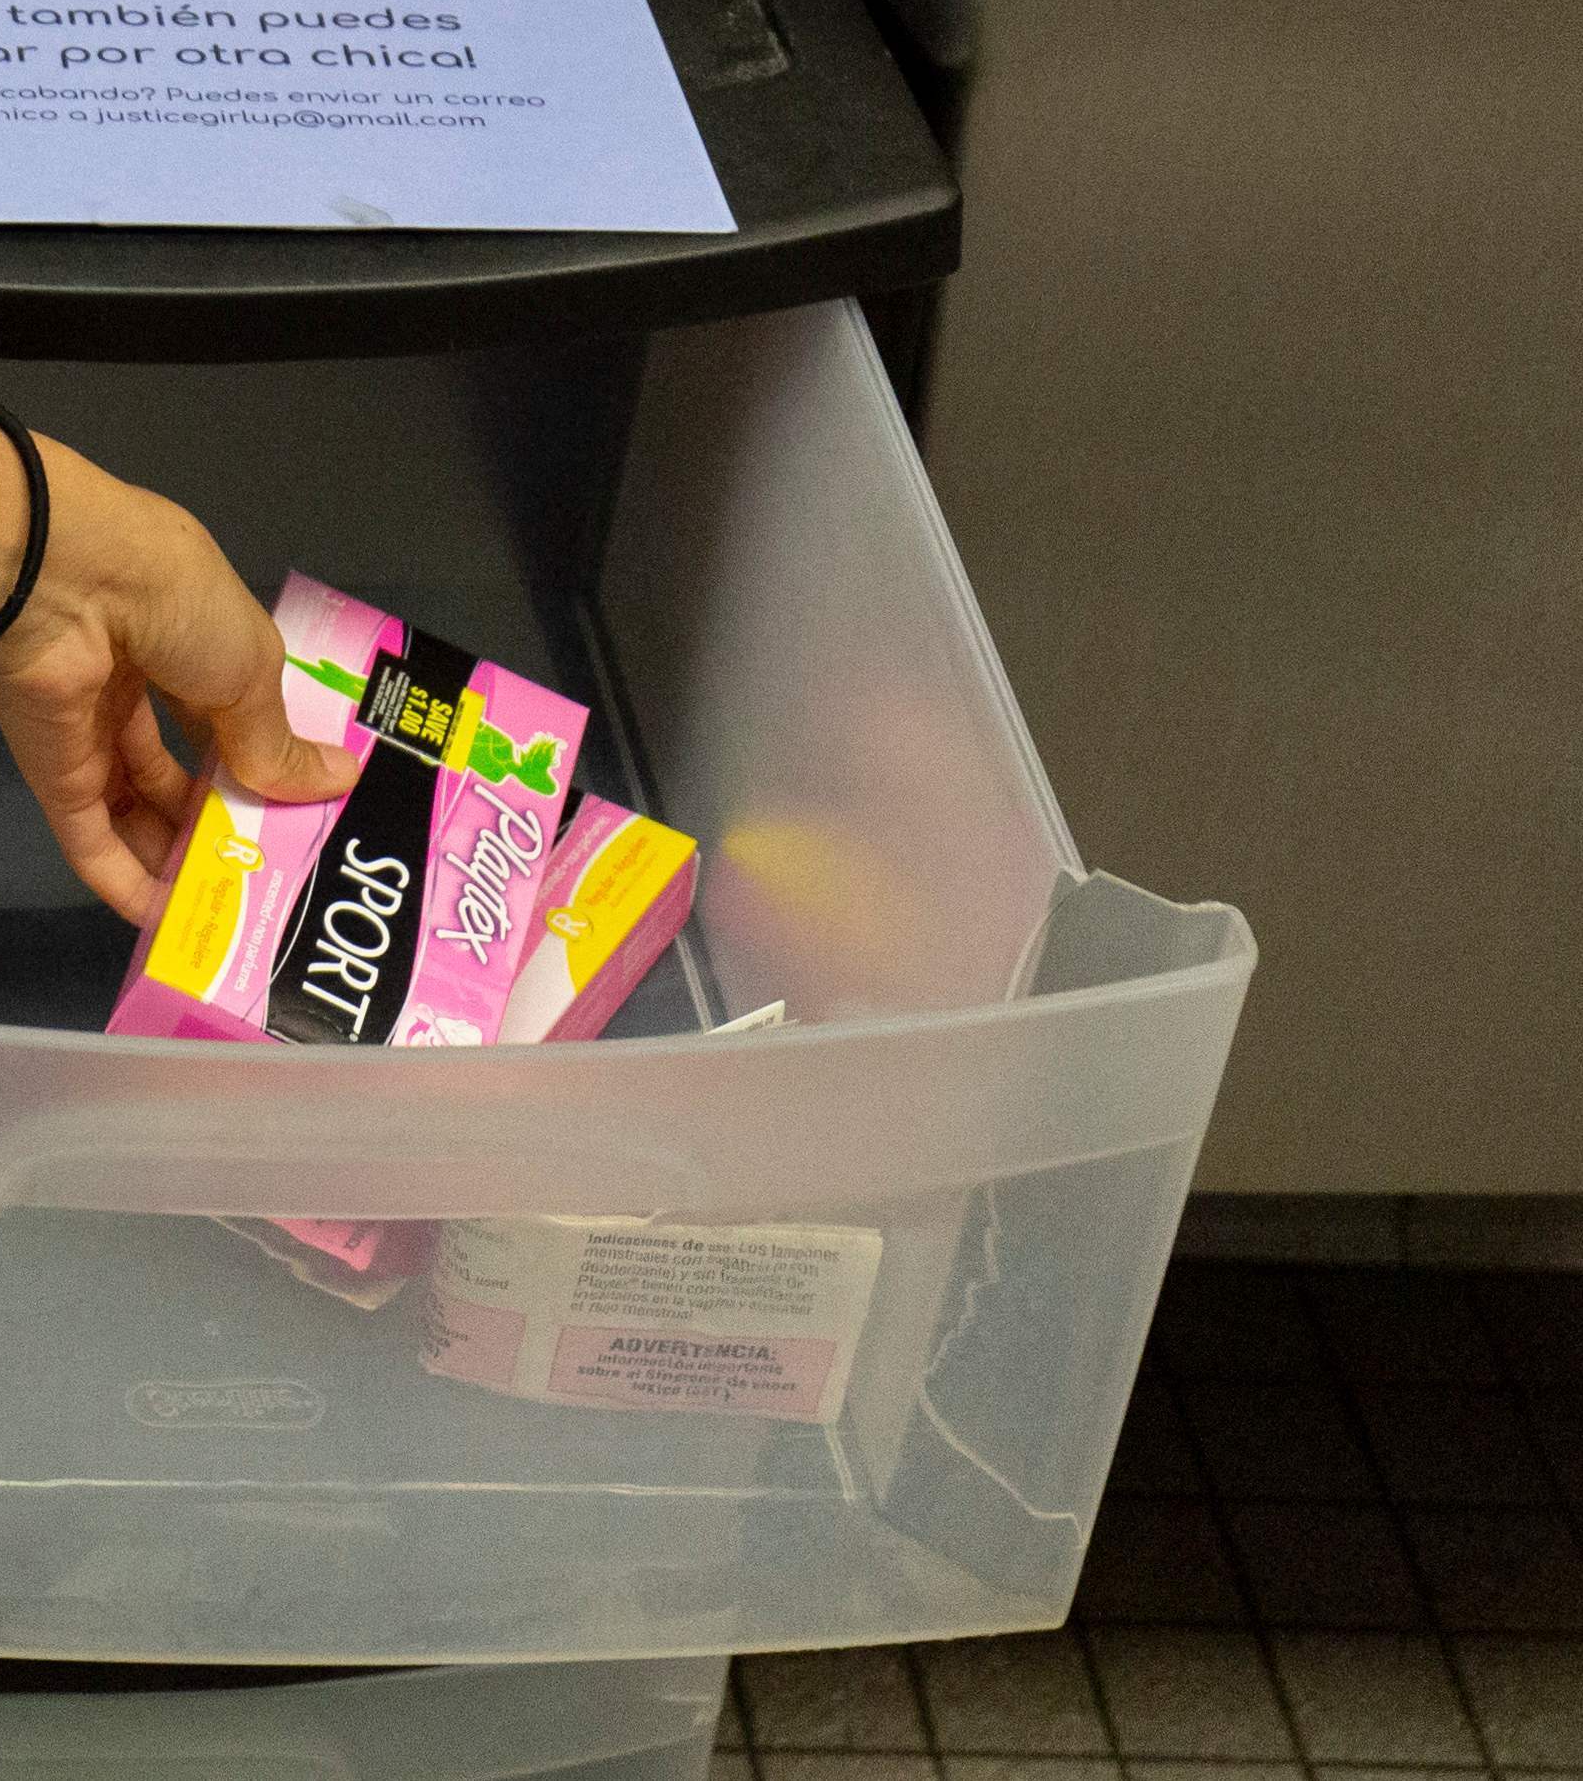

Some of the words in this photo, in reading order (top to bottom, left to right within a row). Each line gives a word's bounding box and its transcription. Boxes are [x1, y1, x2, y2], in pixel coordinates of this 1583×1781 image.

[7, 4, 237, 27] también
[258, 7, 462, 33] puedes
[60, 46, 156, 69] por
[175, 44, 291, 66] otra
[311, 44, 477, 69] chica!
[166, 87, 278, 103] Puedes
[288, 90, 382, 105] enviar
[393, 93, 434, 105] un
[444, 94, 546, 108] correo
[69, 110, 88, 121] a
[95, 108, 487, 129] justicegirlup@gmail.com
[397, 685, 431, 737] $1.00
[419, 698, 454, 746] SAVE
[221, 840, 260, 868] R
[436, 784, 545, 965] Playtex
[302, 837, 410, 1035] SPORT
[587, 1233, 677, 1250] Indicaciones
[682, 1238, 704, 1252] de
[576, 1365, 621, 1378] sobre
